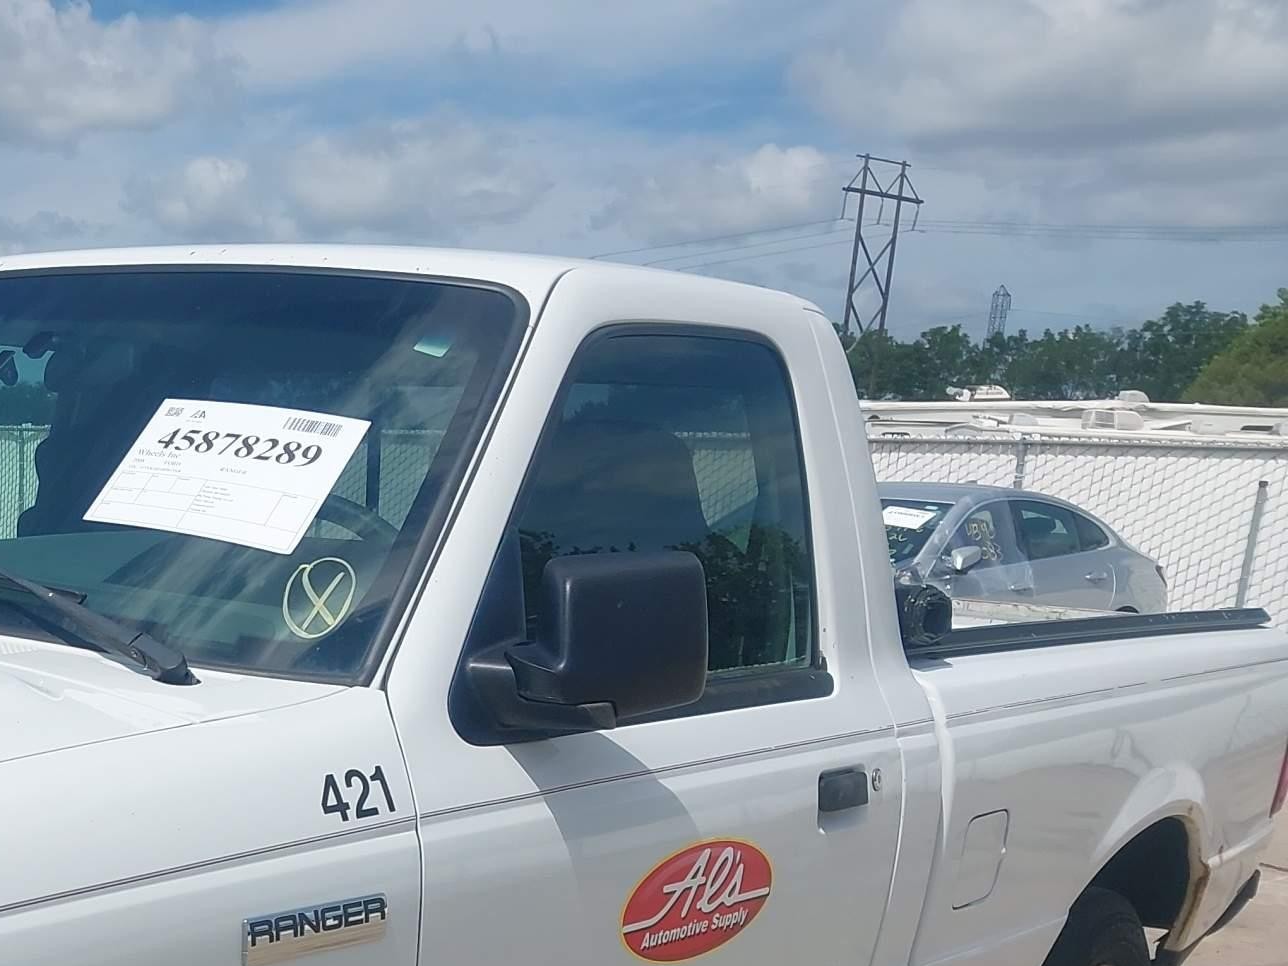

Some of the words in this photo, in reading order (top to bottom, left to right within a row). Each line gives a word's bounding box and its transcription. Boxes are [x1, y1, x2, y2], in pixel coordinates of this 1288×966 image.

[157, 428, 323, 467] 45878289
[321, 765, 396, 822] 421
[248, 897, 387, 947] RANGER
[640, 919, 709, 950] Automotive
[711, 907, 749, 931] Supply
